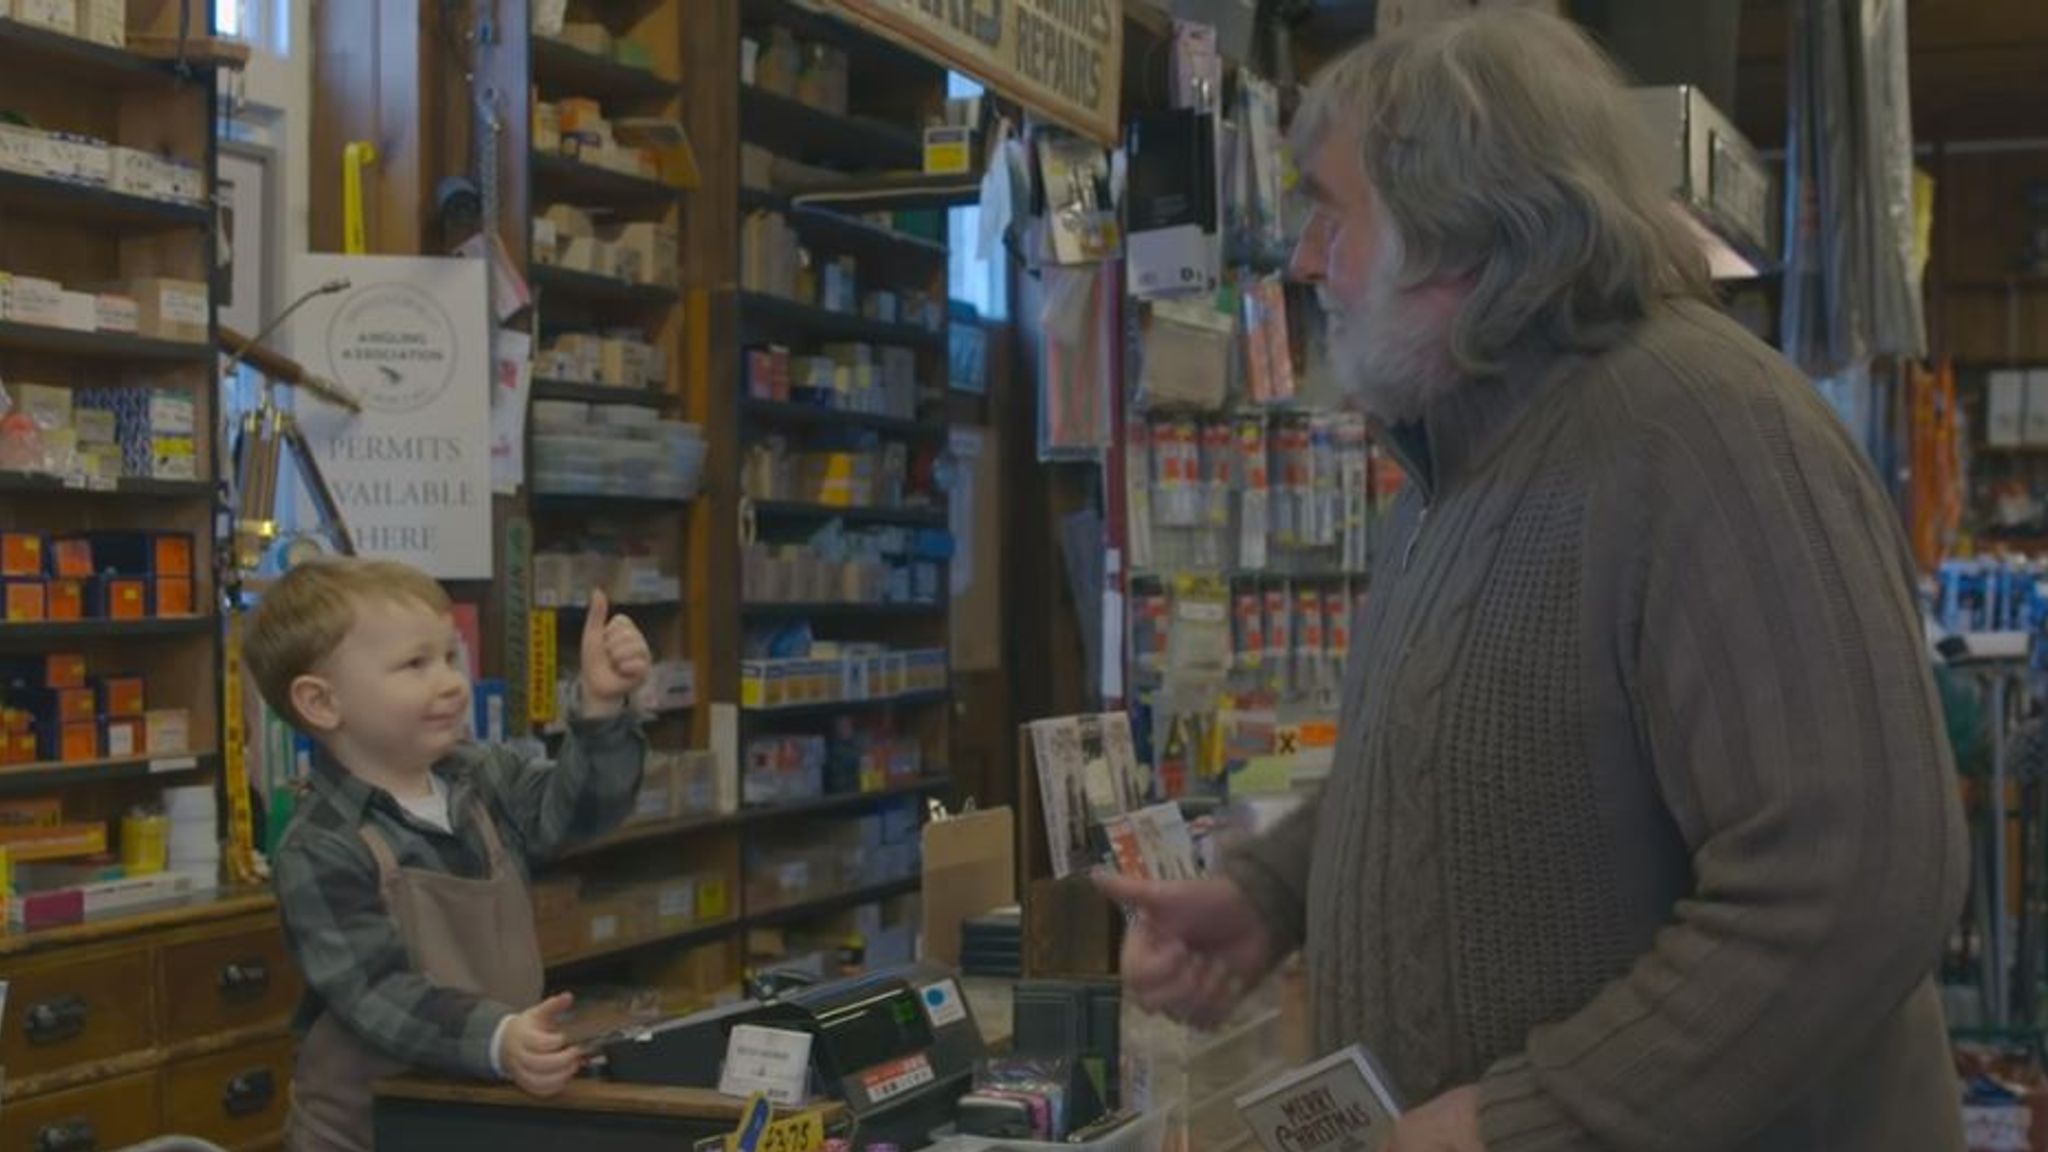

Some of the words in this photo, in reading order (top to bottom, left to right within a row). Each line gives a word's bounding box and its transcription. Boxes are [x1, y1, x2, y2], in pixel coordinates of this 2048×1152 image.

[1015, 5, 1101, 111] REPAIRS
[357, 331, 427, 345] ANGLING
[341, 347, 445, 361] ASSOCIATION
[328, 436, 462, 461] PERMITS
[330, 480, 476, 507] VAILABLE
[355, 525, 438, 551] HERE
